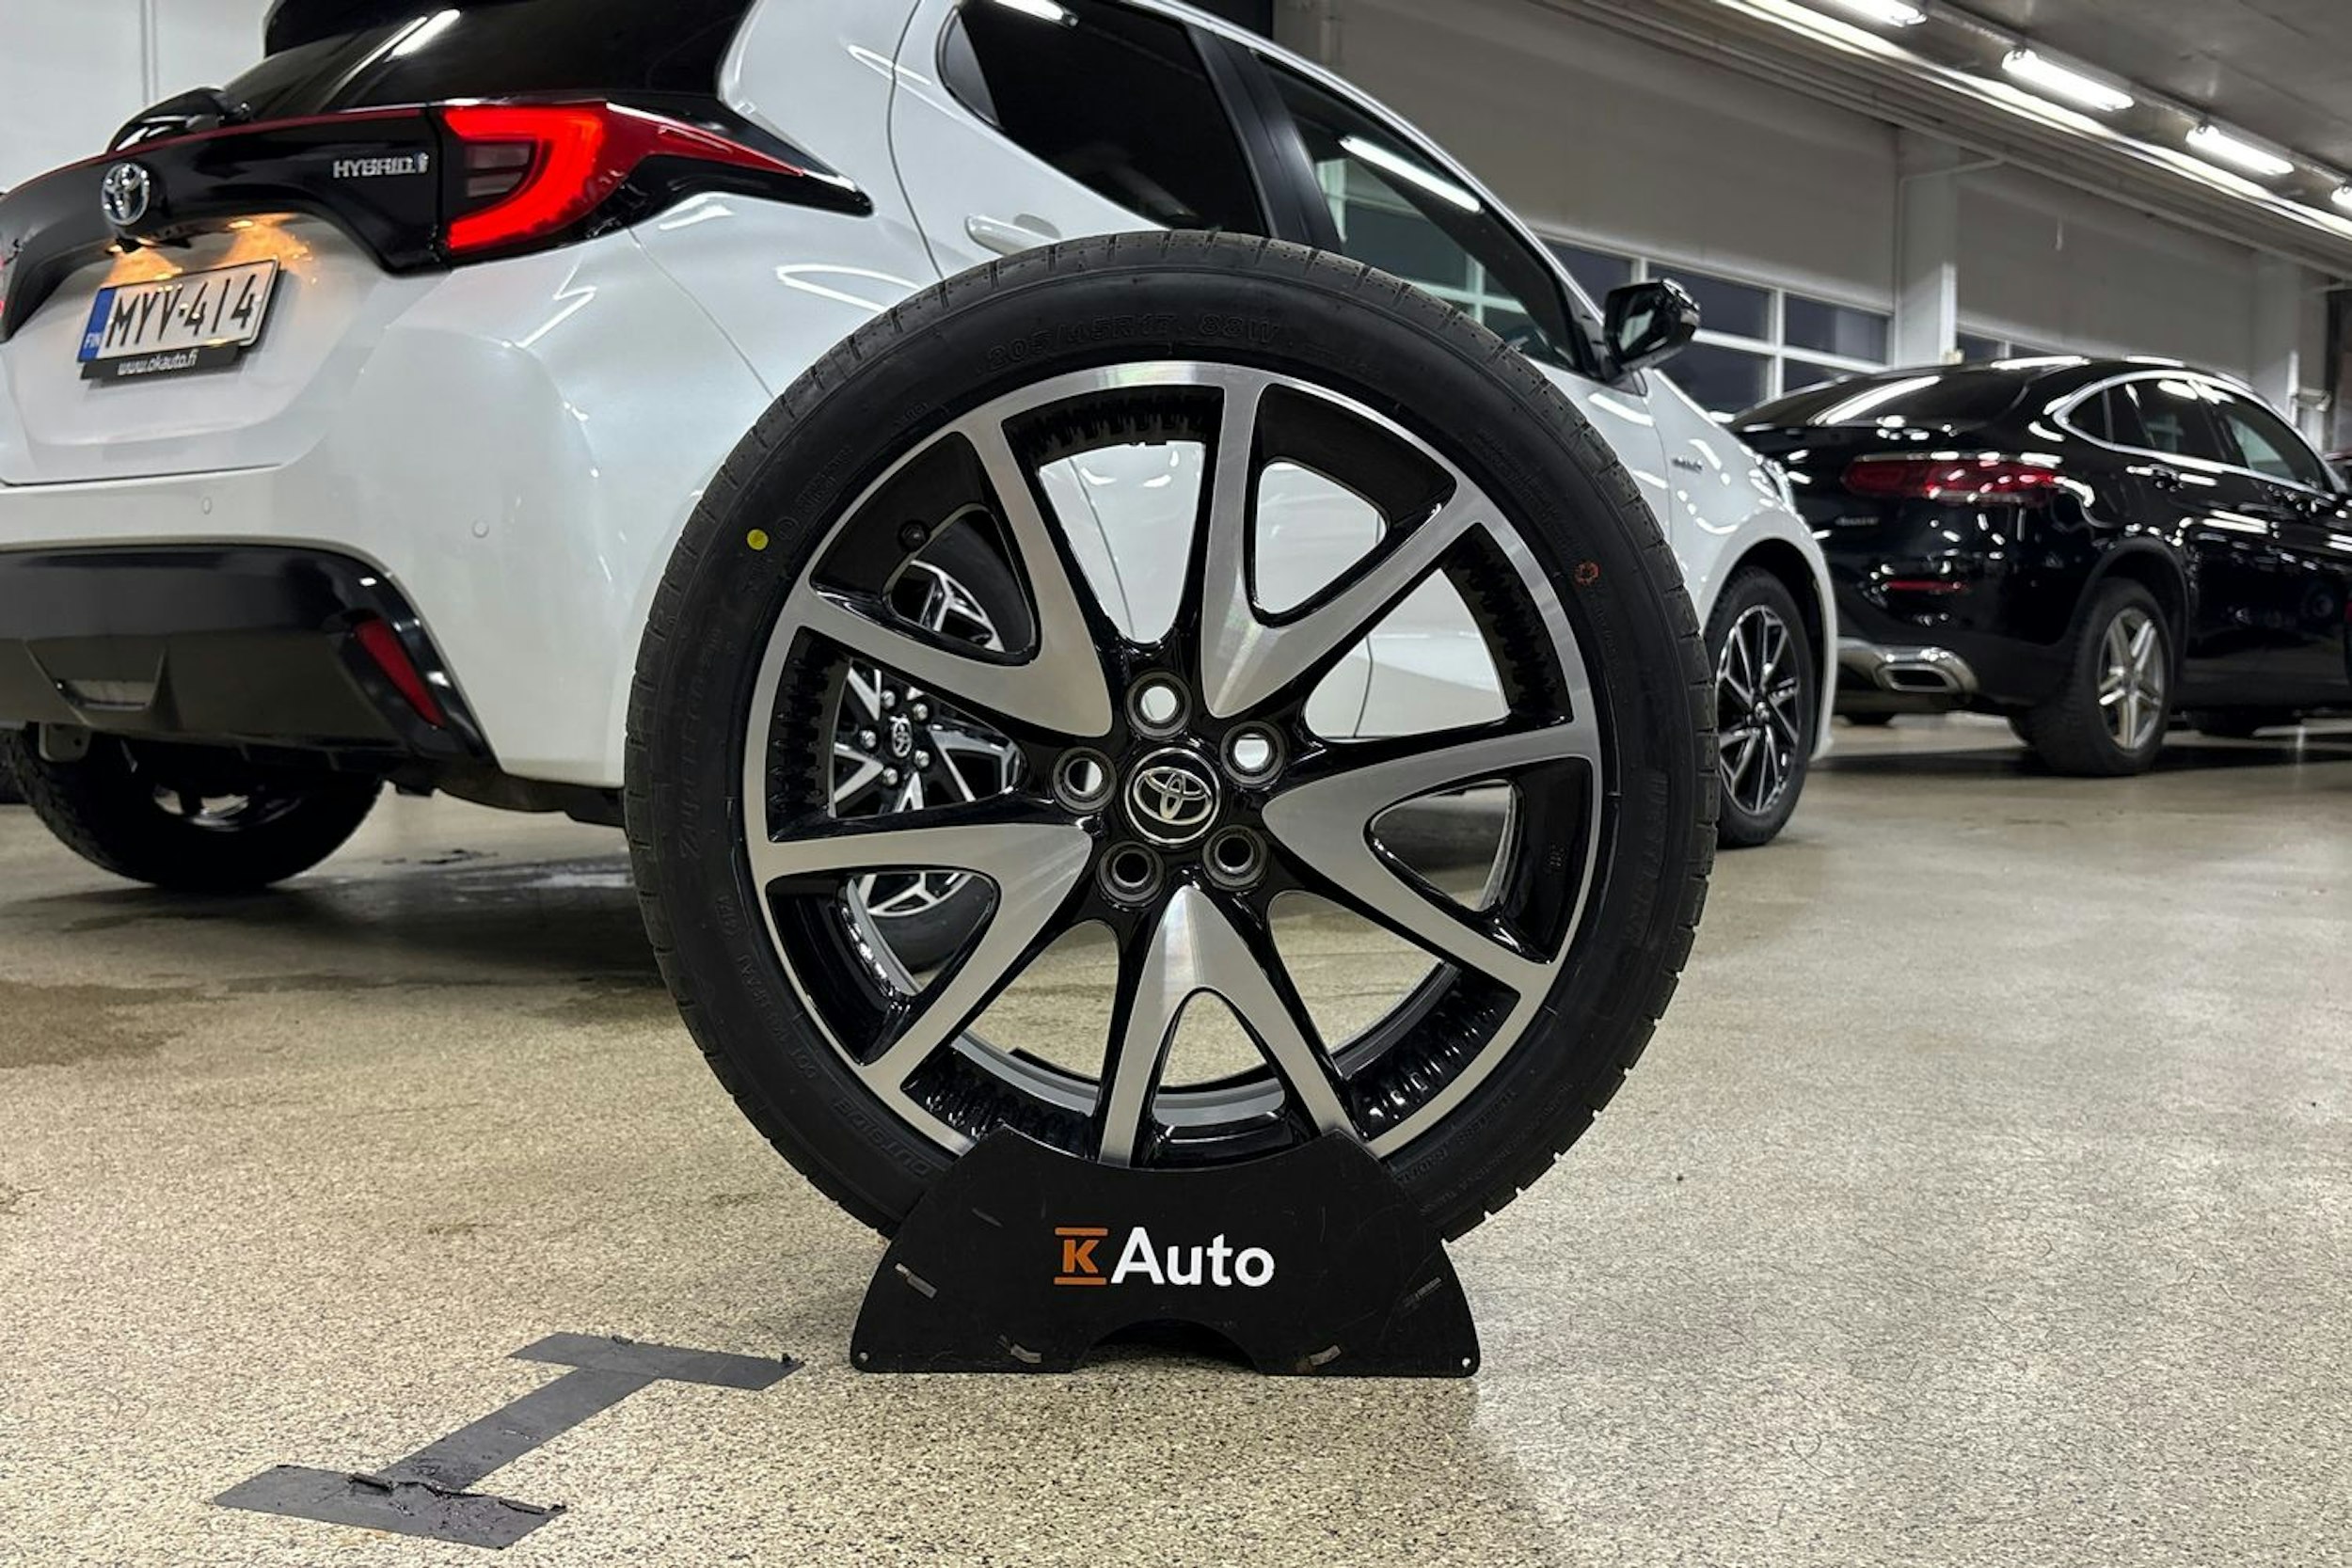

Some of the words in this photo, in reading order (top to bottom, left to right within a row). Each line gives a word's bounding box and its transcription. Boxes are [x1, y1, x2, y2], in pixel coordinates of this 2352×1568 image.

[333, 157, 416, 179] HYBRID
[105, 274, 257, 349] MYV-414
[117, 349, 199, 376] www.okauto.fi
[1110, 1226, 1275, 1288] Auto
